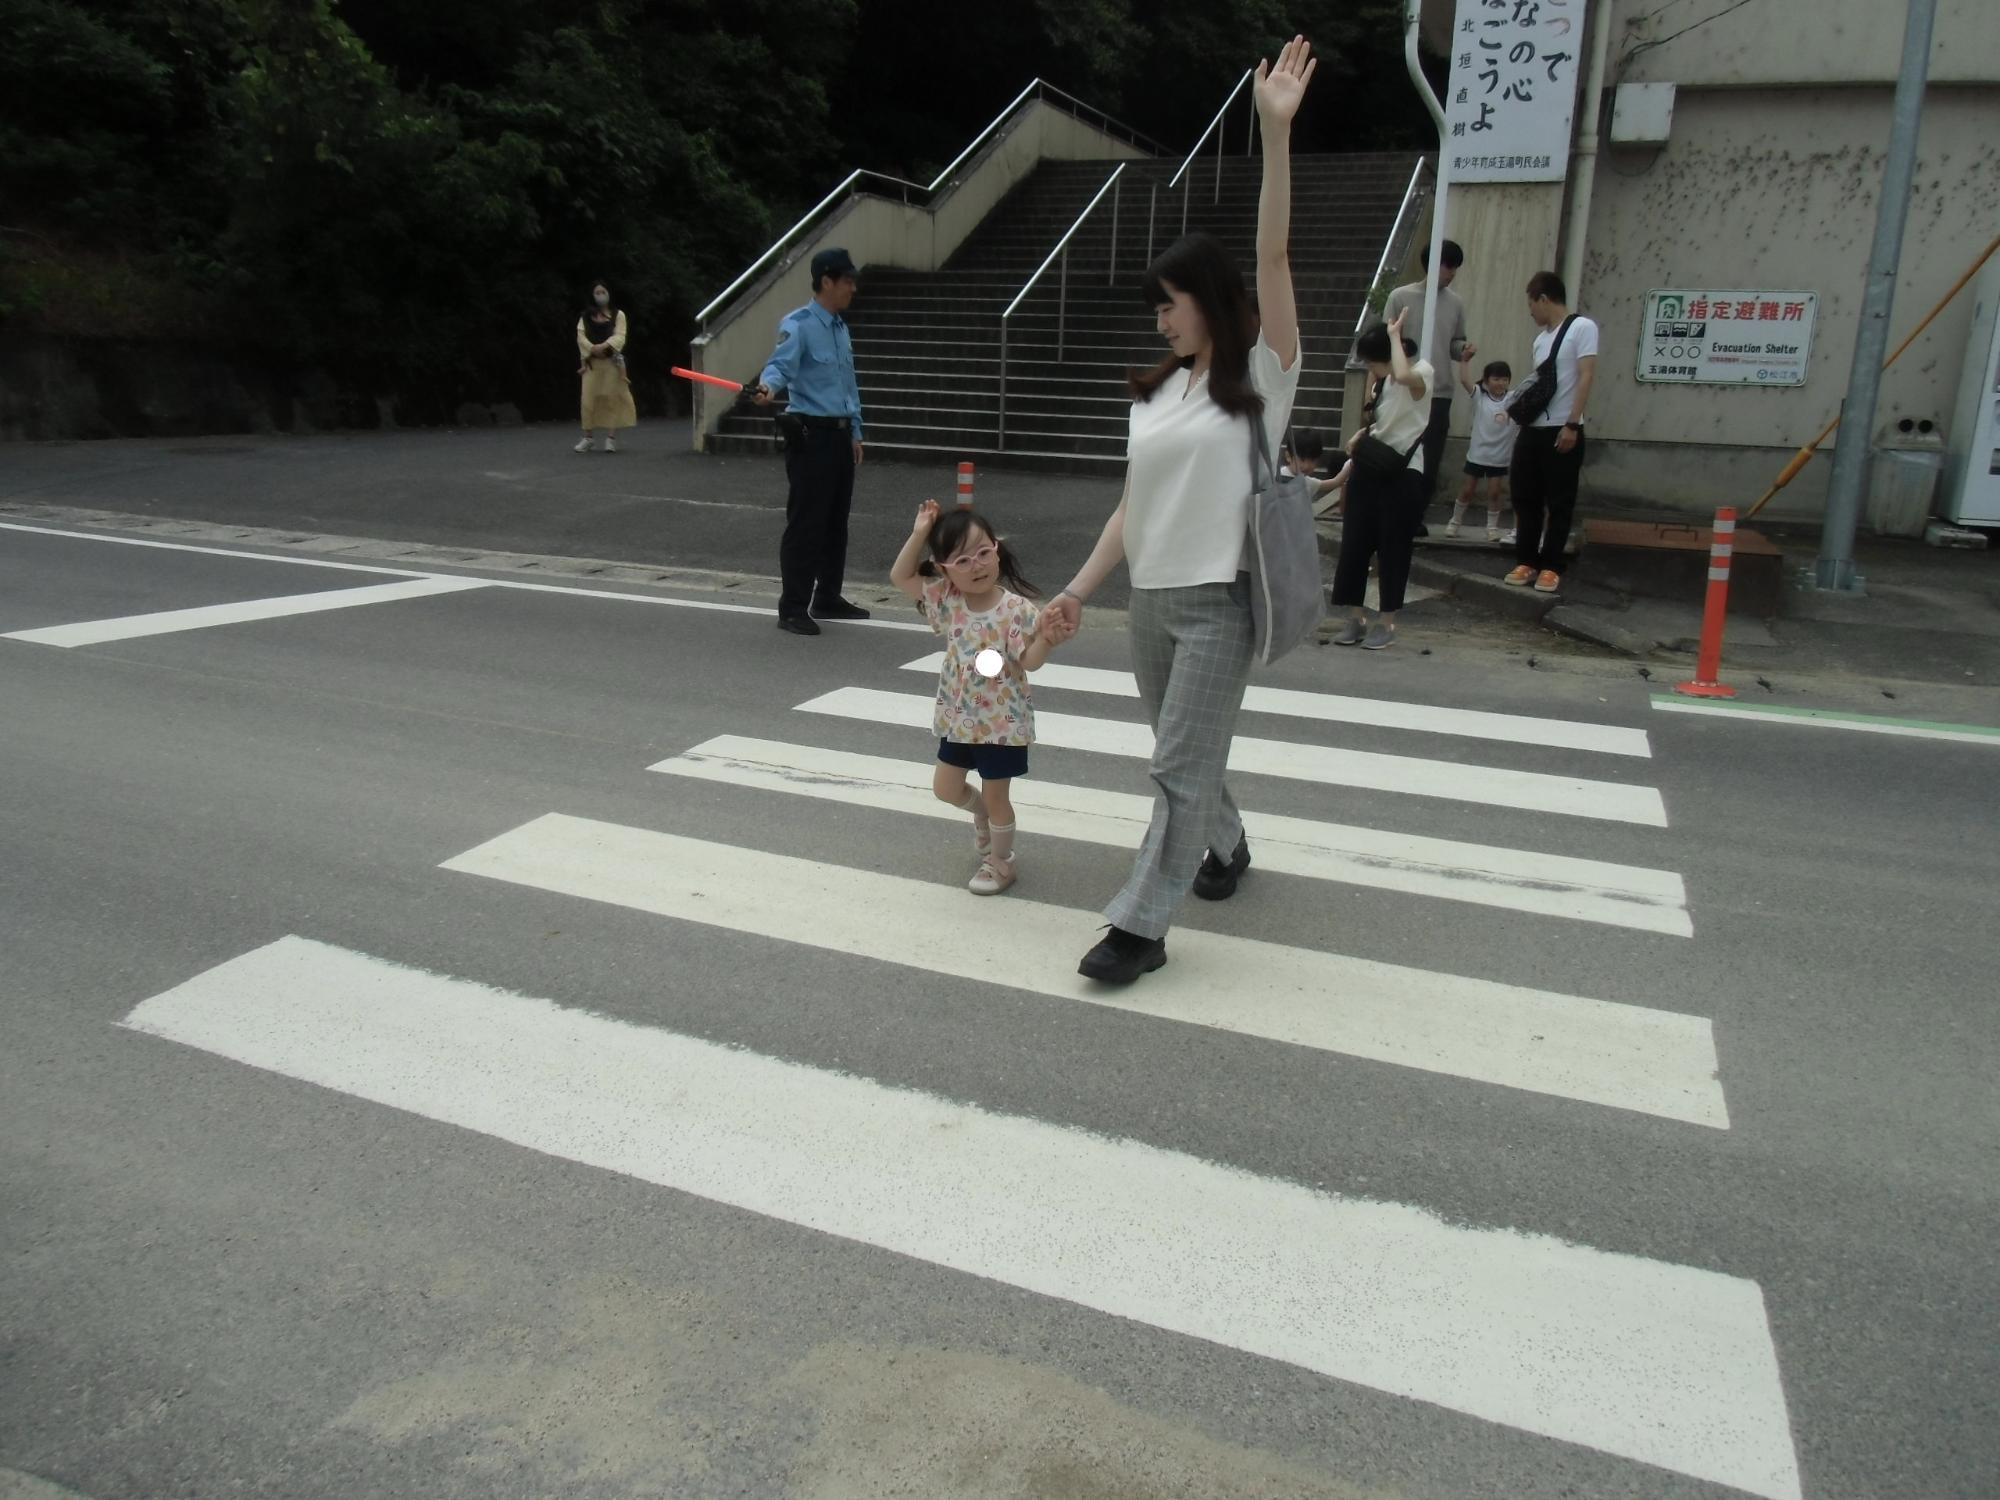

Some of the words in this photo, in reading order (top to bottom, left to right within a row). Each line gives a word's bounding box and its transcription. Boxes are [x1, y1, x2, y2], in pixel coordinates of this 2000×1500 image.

[1687, 300, 1805, 321] 指定避難所
[1712, 342, 1761, 353] Evacuation
[1765, 343, 1798, 355] Shelter
